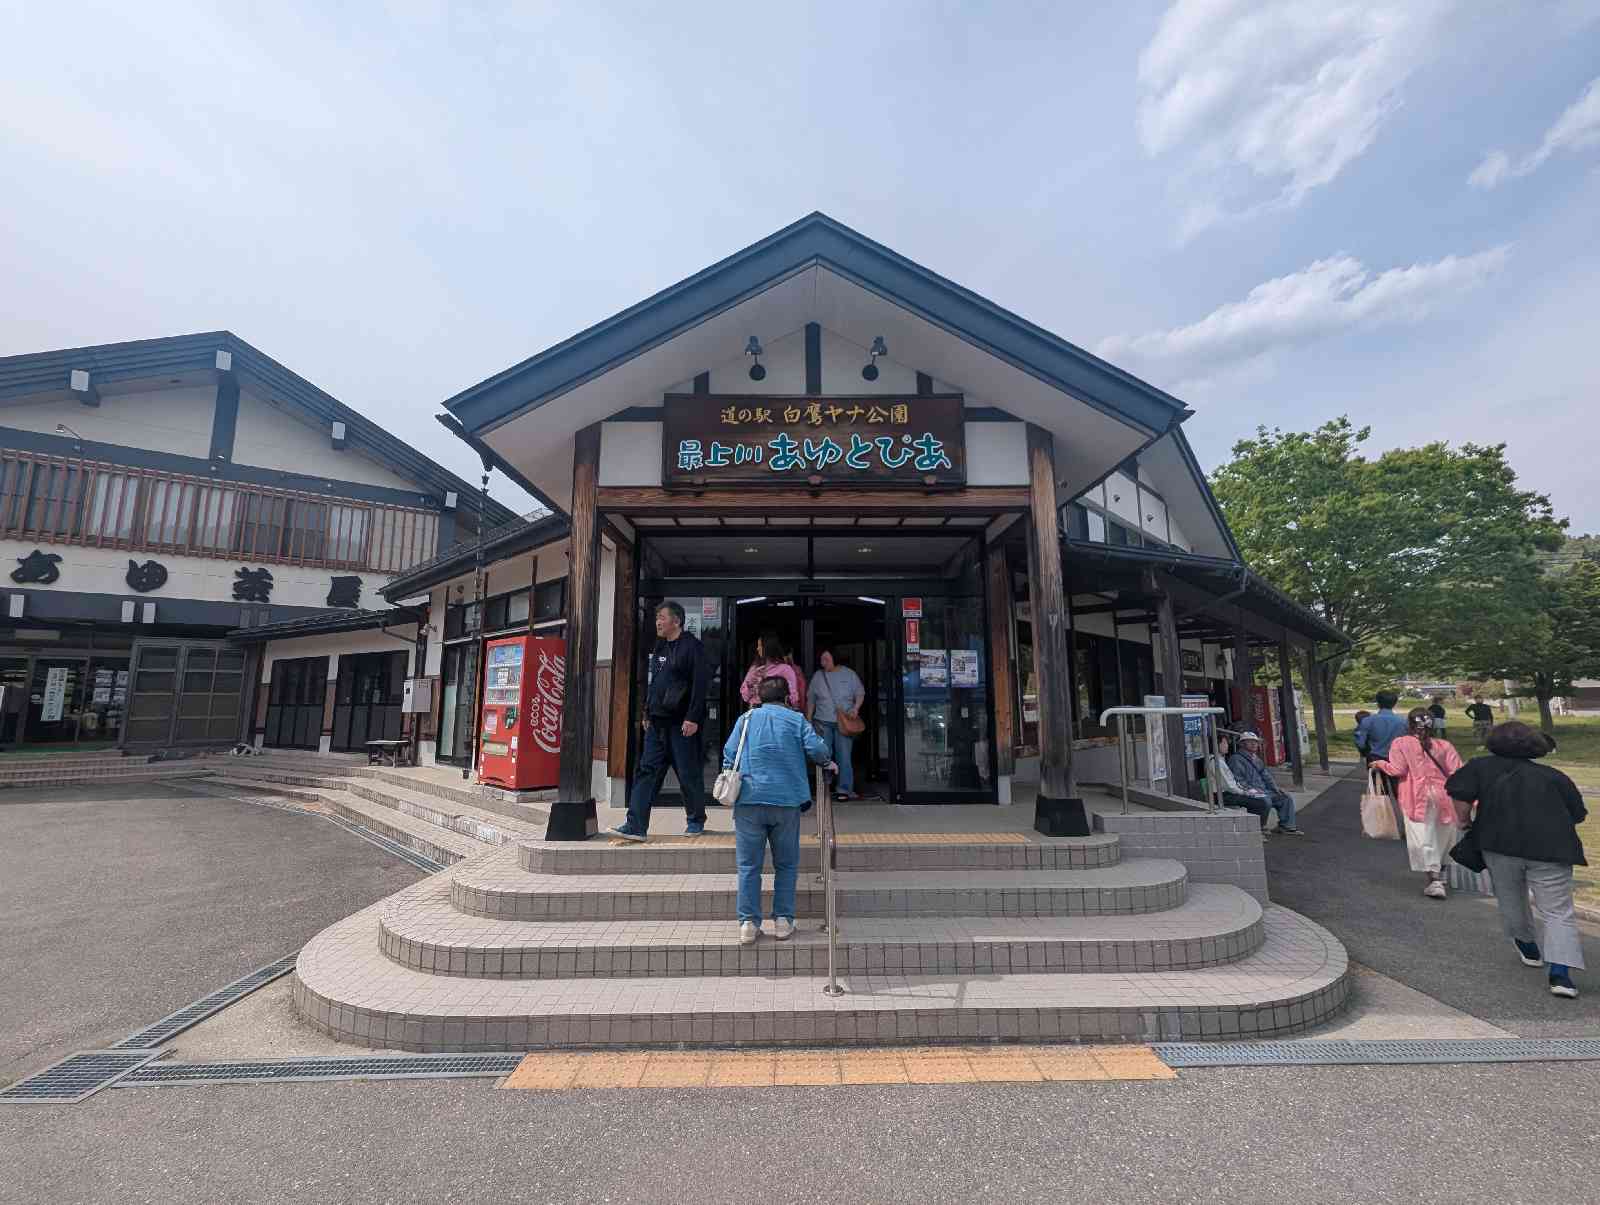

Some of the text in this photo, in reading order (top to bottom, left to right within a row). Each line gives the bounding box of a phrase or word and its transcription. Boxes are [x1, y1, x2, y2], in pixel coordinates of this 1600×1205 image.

[720, 401, 909, 425] 道の駅 白鷹ヤナ公園
